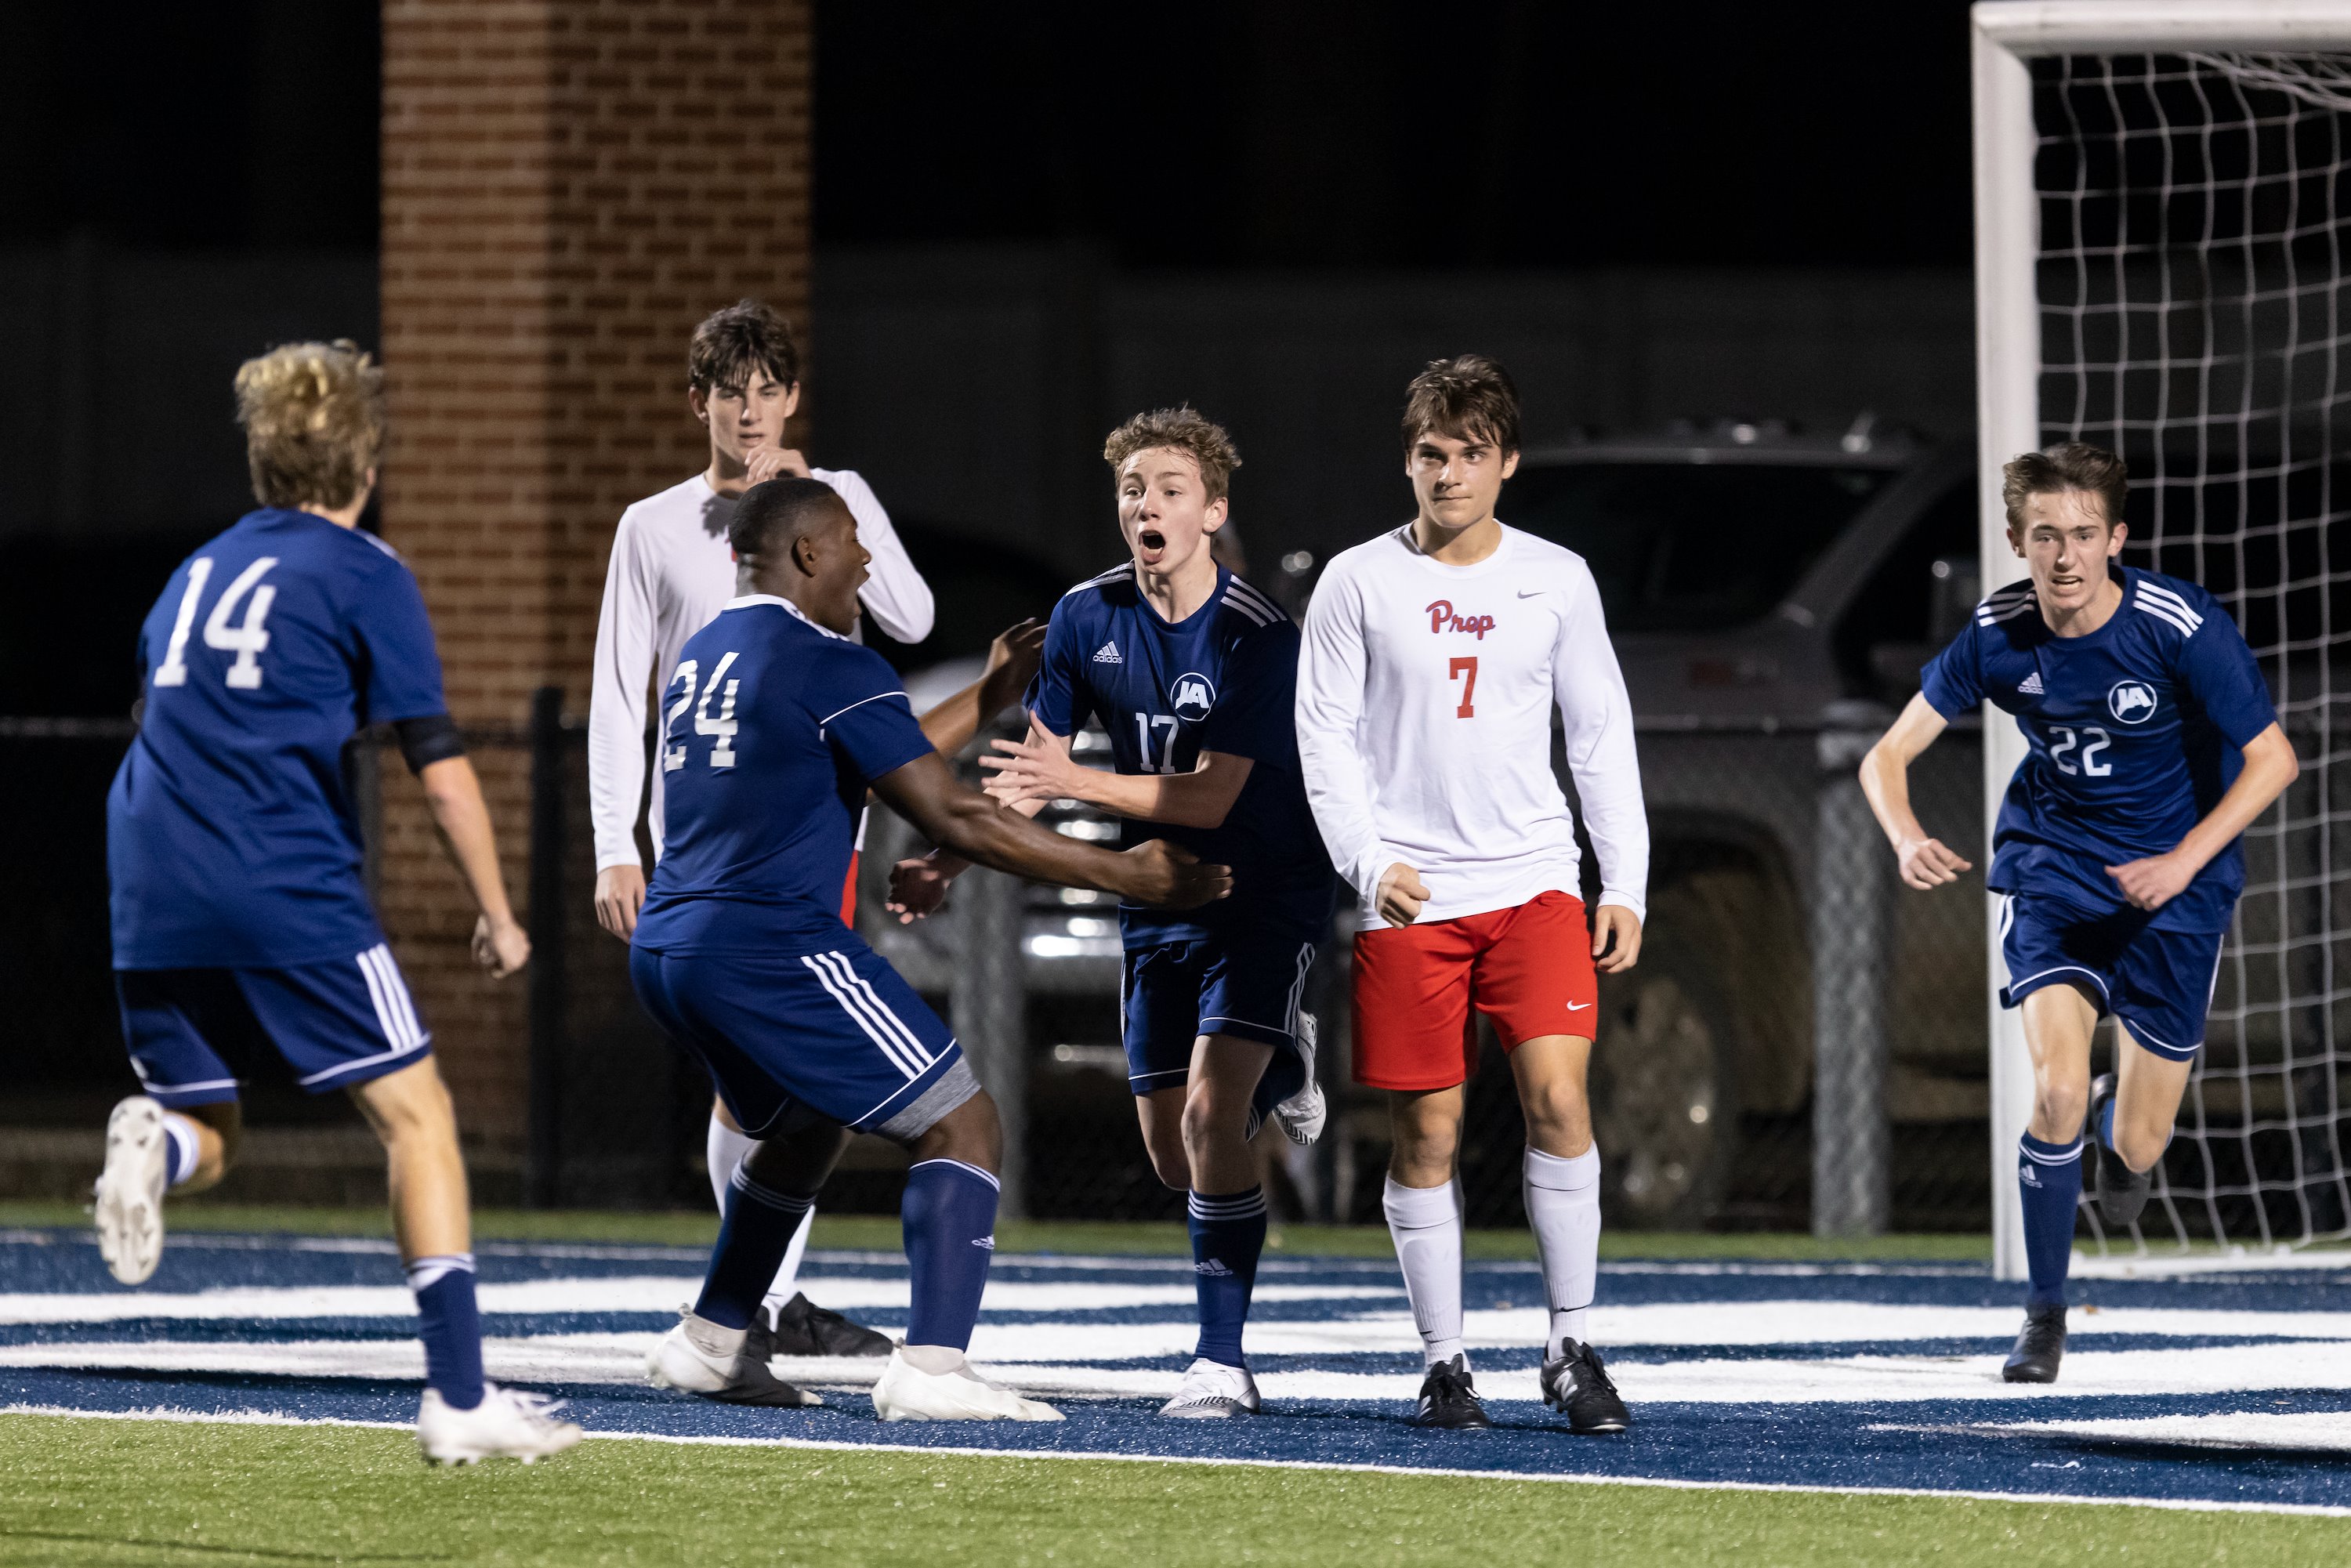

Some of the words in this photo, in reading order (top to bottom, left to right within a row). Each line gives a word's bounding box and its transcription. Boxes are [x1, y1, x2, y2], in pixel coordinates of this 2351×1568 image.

[154, 556, 279, 690] 14
[1426, 599, 1496, 641] Prep
[1092, 654, 1123, 664] adidas
[1450, 657, 1478, 719] 7
[663, 651, 741, 773] 24
[1136, 712, 1179, 775] 17
[2049, 726, 2113, 777] 22
